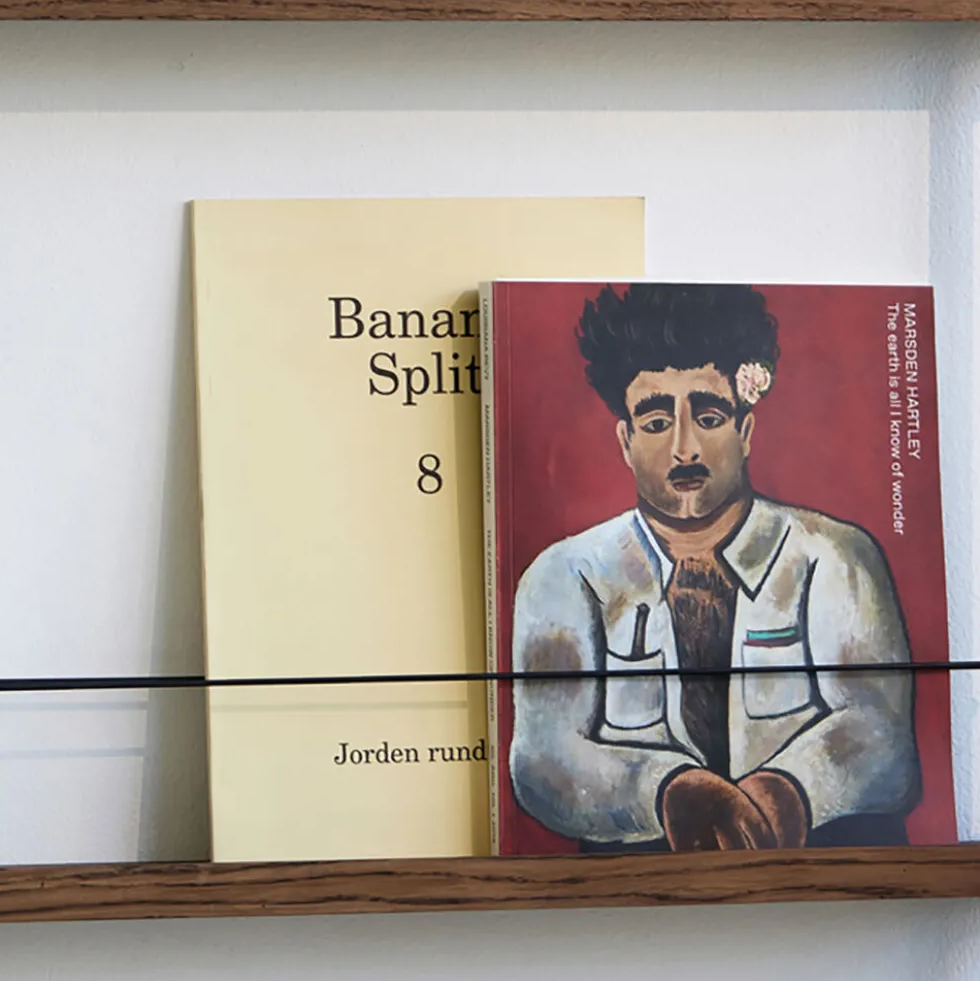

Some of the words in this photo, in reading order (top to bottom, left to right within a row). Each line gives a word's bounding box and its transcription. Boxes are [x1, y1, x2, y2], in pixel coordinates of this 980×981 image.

[887, 302, 900, 330] The
[887, 334, 901, 372] earth
[903, 302, 918, 382] MARSDEN
[369, 352, 482, 406] Split
[889, 376, 901, 388] is
[890, 391, 902, 407] all
[890, 419, 903, 459] know
[906, 386, 921, 460] HARTLEY
[417, 453, 443, 494] 8
[891, 462, 904, 477] of
[892, 480, 906, 536] wonder
[334, 741, 420, 765] Jorden
[428, 738, 488, 762] rund
